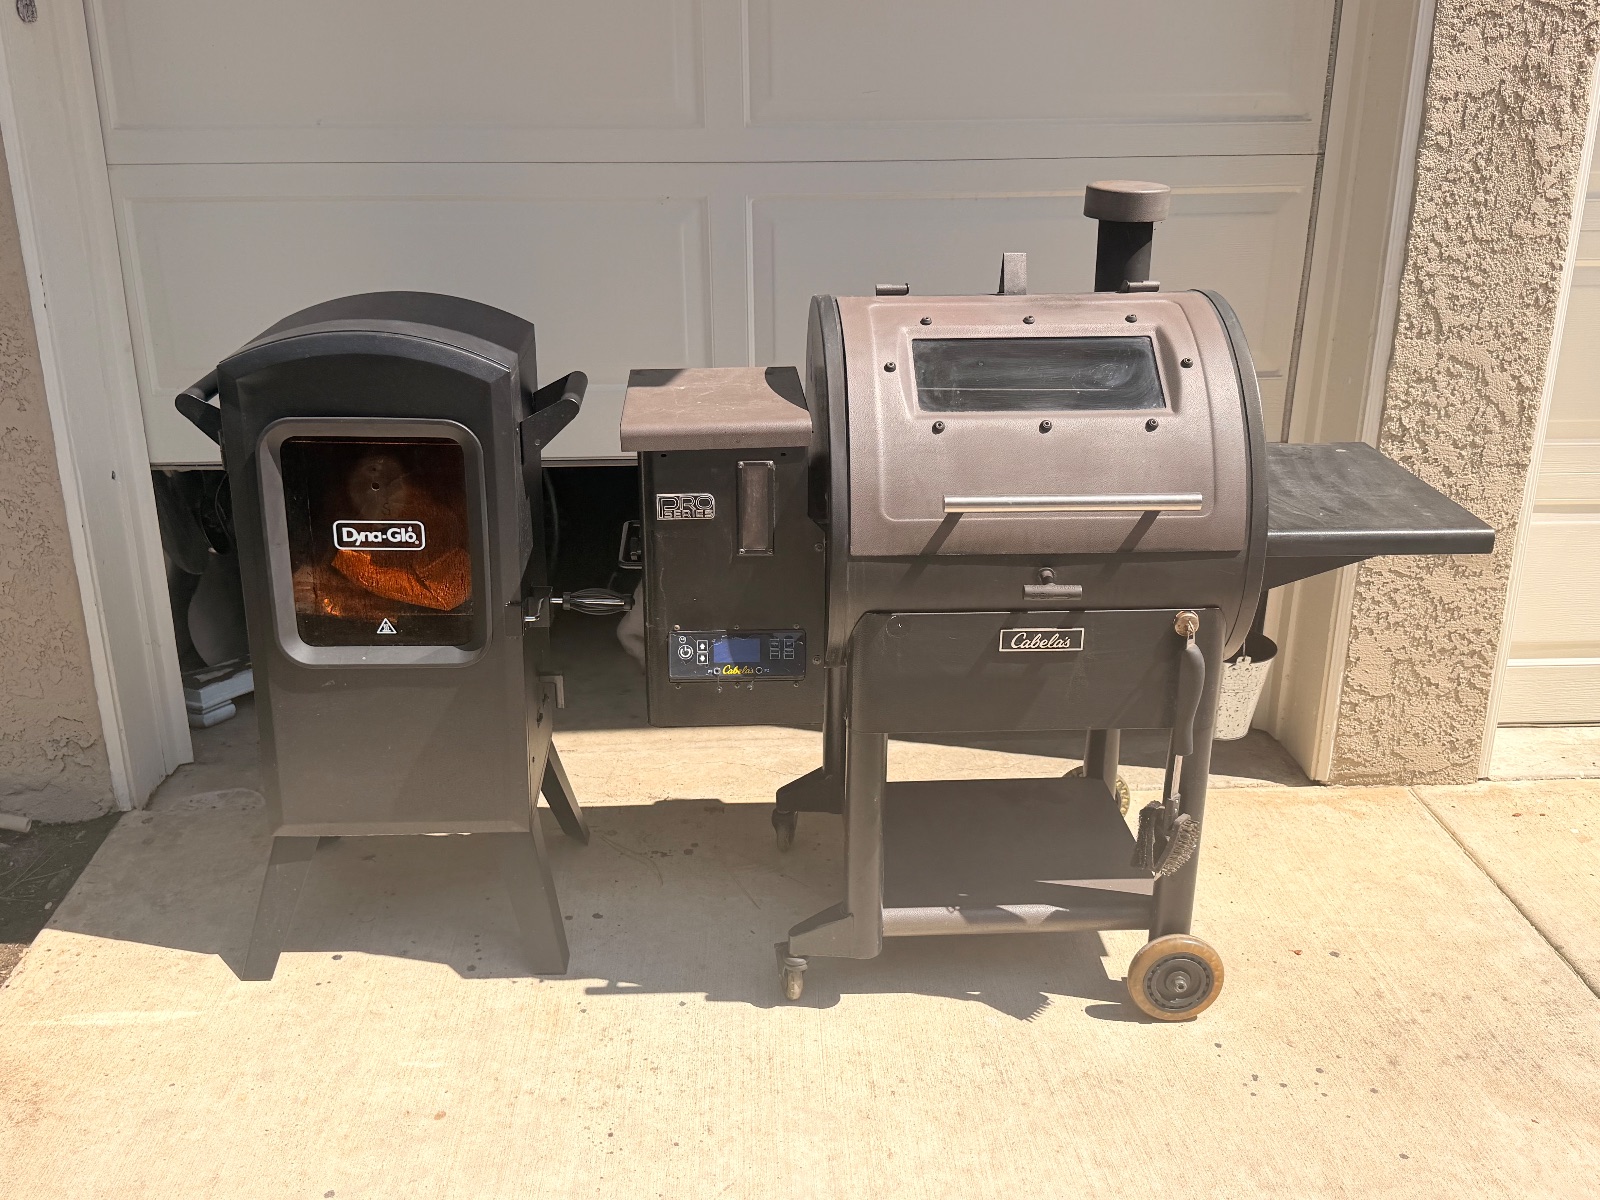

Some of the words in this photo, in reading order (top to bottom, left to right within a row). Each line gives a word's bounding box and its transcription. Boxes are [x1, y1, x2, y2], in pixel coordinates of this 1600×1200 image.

[658, 495, 713, 517] PRO
[663, 509, 714, 518] SERIES
[342, 526, 417, 546] Dyna-Glo
[1011, 632, 1071, 649] Cabela's
